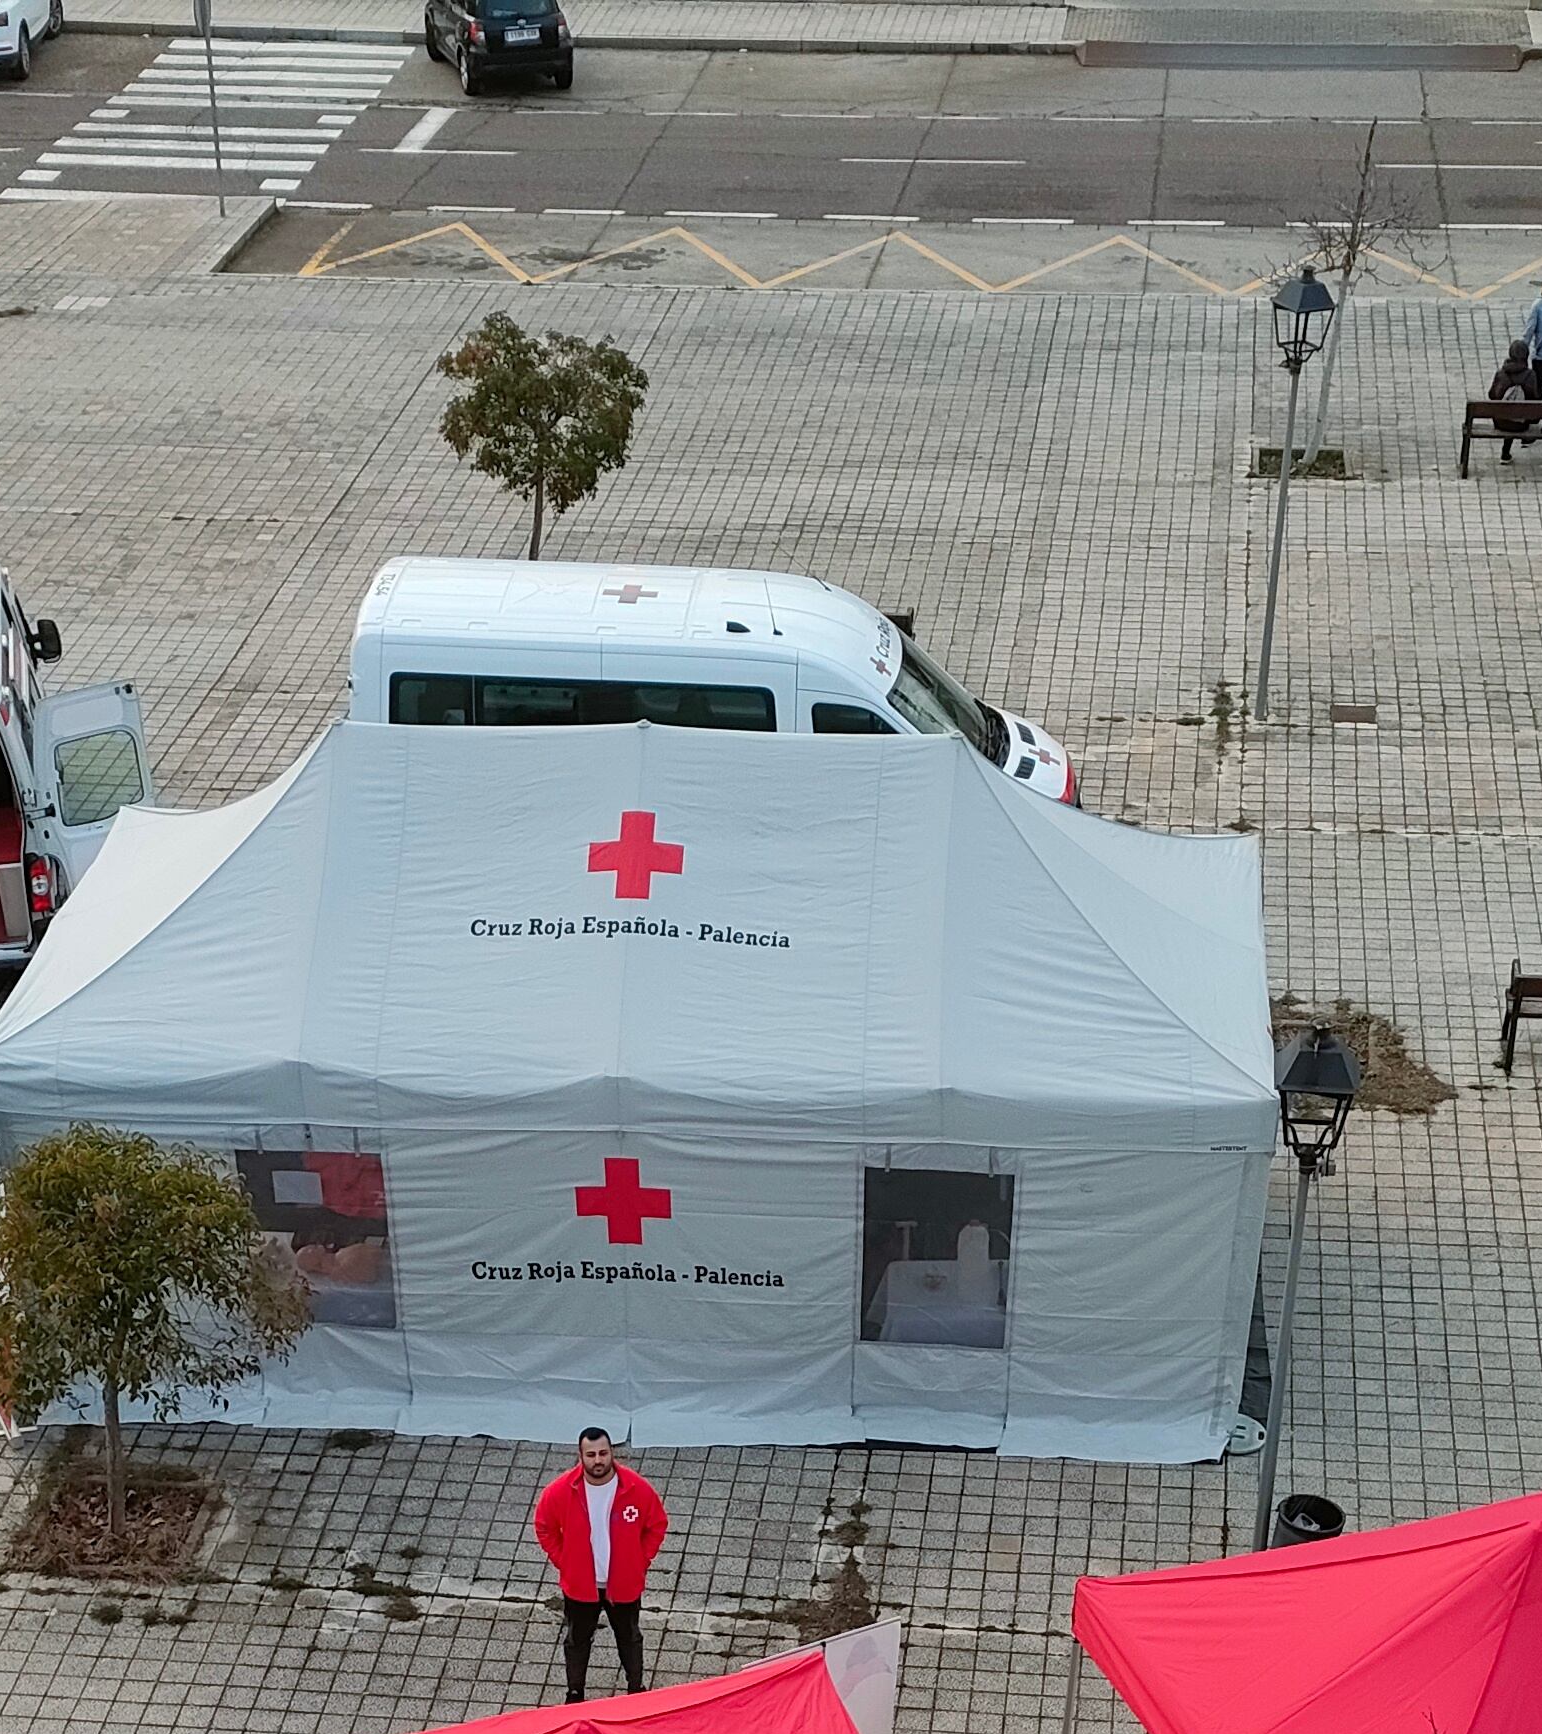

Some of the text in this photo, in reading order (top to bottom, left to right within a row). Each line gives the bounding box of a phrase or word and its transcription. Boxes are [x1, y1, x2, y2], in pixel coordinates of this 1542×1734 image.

[470, 919, 522, 937] Cruz
[528, 917, 576, 939] Roja
[581, 916, 680, 938] Española
[698, 923, 791, 949] Palencia
[471, 1261, 523, 1280] Cruz
[527, 1261, 575, 1283] Roja
[580, 1261, 677, 1283] Española
[694, 1266, 785, 1287] Palencia
